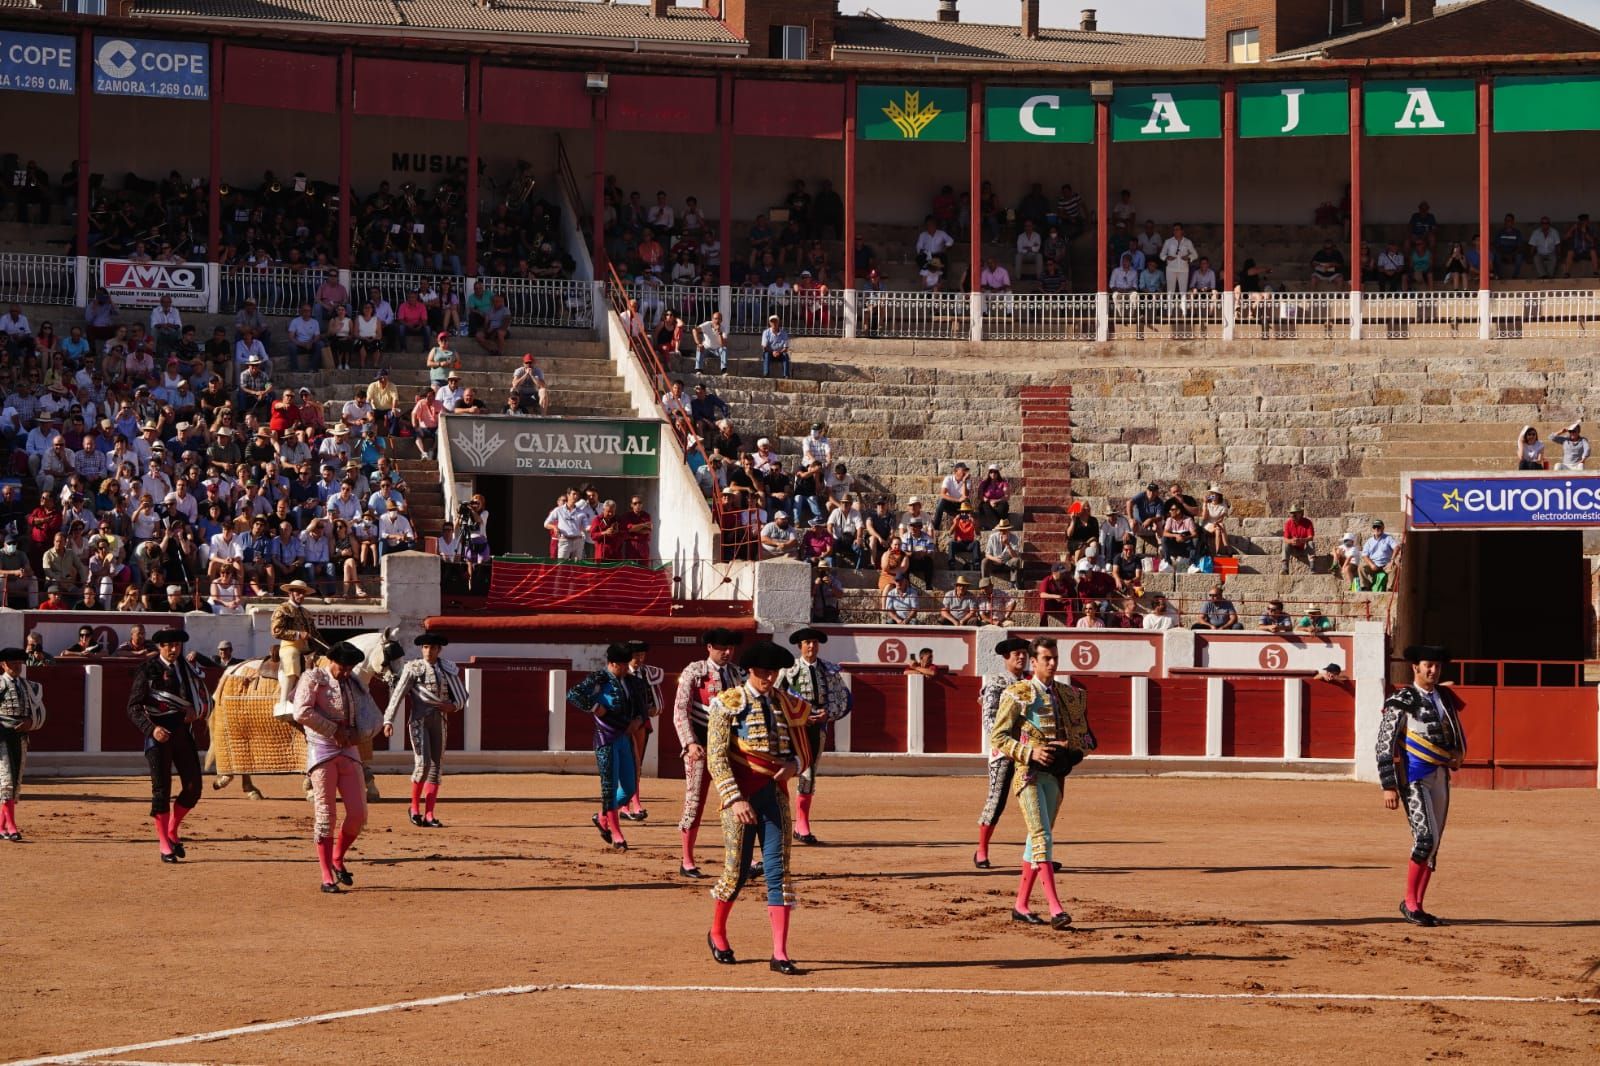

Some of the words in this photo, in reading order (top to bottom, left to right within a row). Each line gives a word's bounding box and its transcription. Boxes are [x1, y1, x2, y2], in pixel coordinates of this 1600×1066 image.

[9, 44, 72, 68] COPE
[140, 52, 204, 74] COPE
[15, 76, 44, 89] 1.269
[48, 79, 72, 91] O.M.
[97, 80, 146, 94] ZAMORA
[150, 82, 179, 95] 1.269
[183, 85, 207, 97] O.M.
[110, 265, 195, 289] AMAQ
[514, 433, 573, 453] CAJA
[573, 434, 656, 456] RURAL
[516, 458, 533, 468] DE
[538, 458, 593, 470] ZAMORA
[96, 630, 110, 651] 4
[885, 643, 900, 663] 5
[1078, 645, 1093, 666] 5
[1266, 649, 1281, 669] 5
